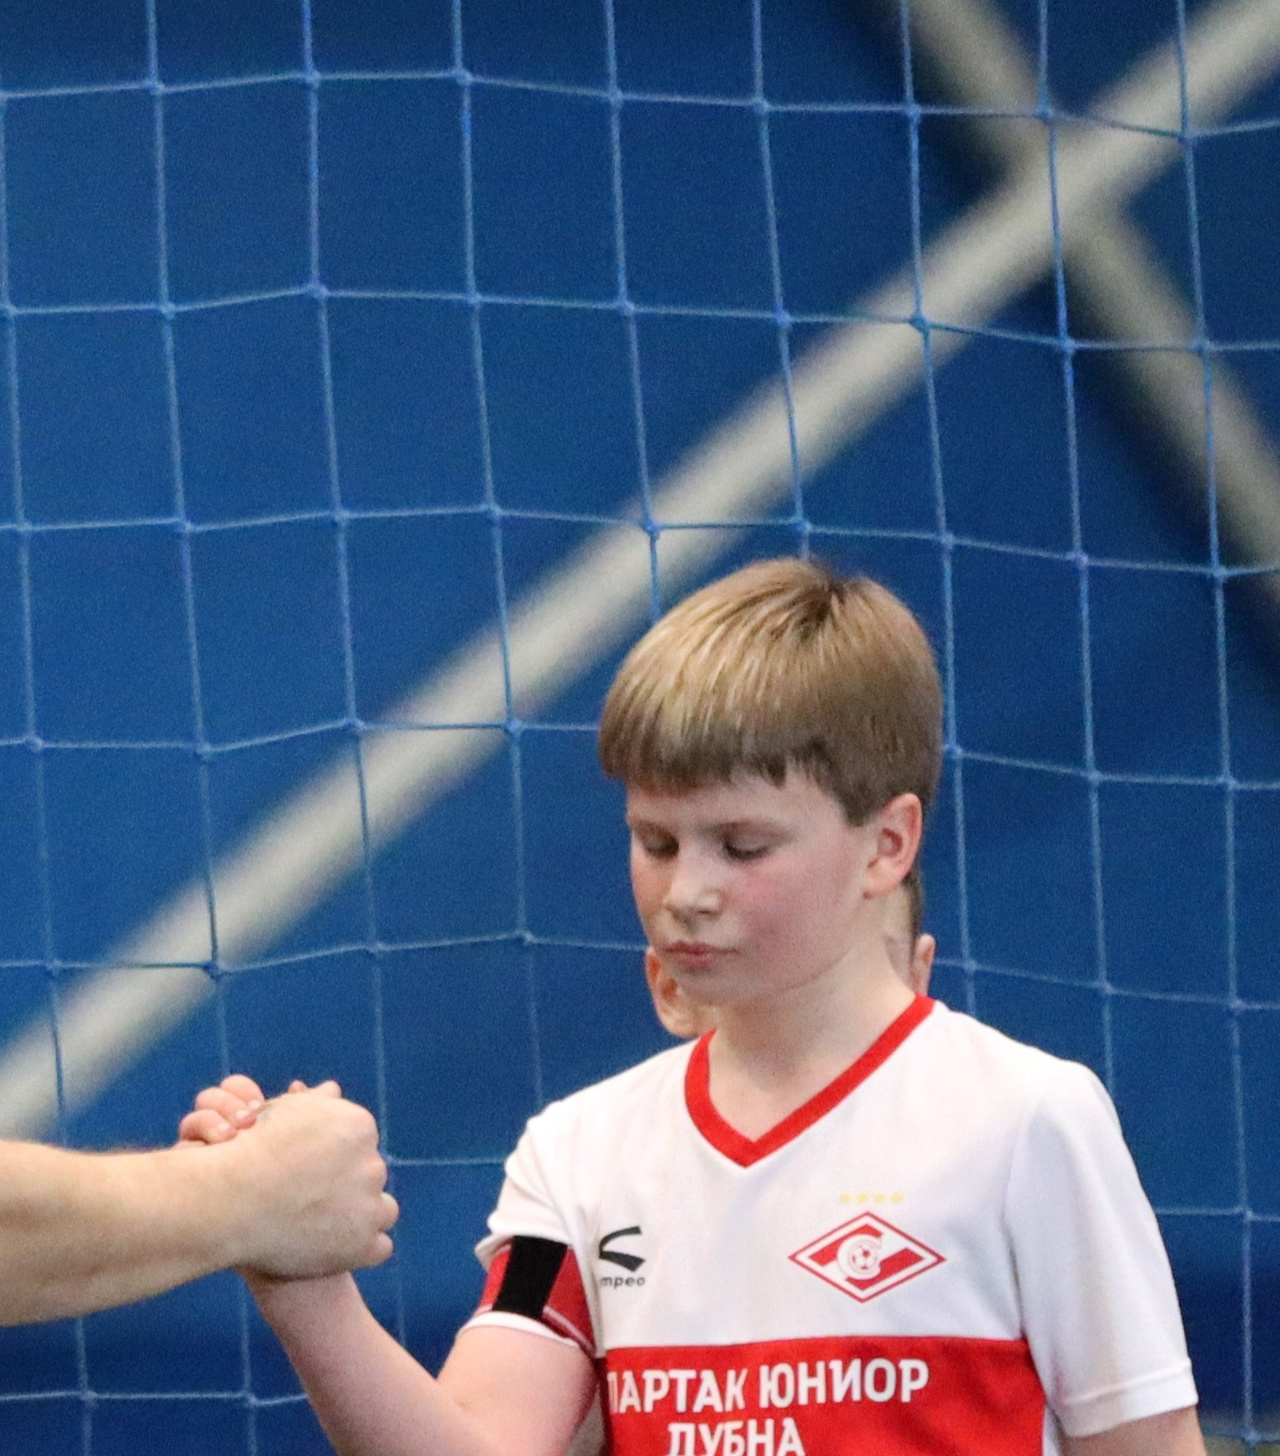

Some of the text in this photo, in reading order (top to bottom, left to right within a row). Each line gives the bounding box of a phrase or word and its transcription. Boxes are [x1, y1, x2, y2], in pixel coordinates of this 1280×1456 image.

[600, 1276, 646, 1290] mpeo
[607, 1358, 929, 1415] ПАРТАК ЮНИОР
